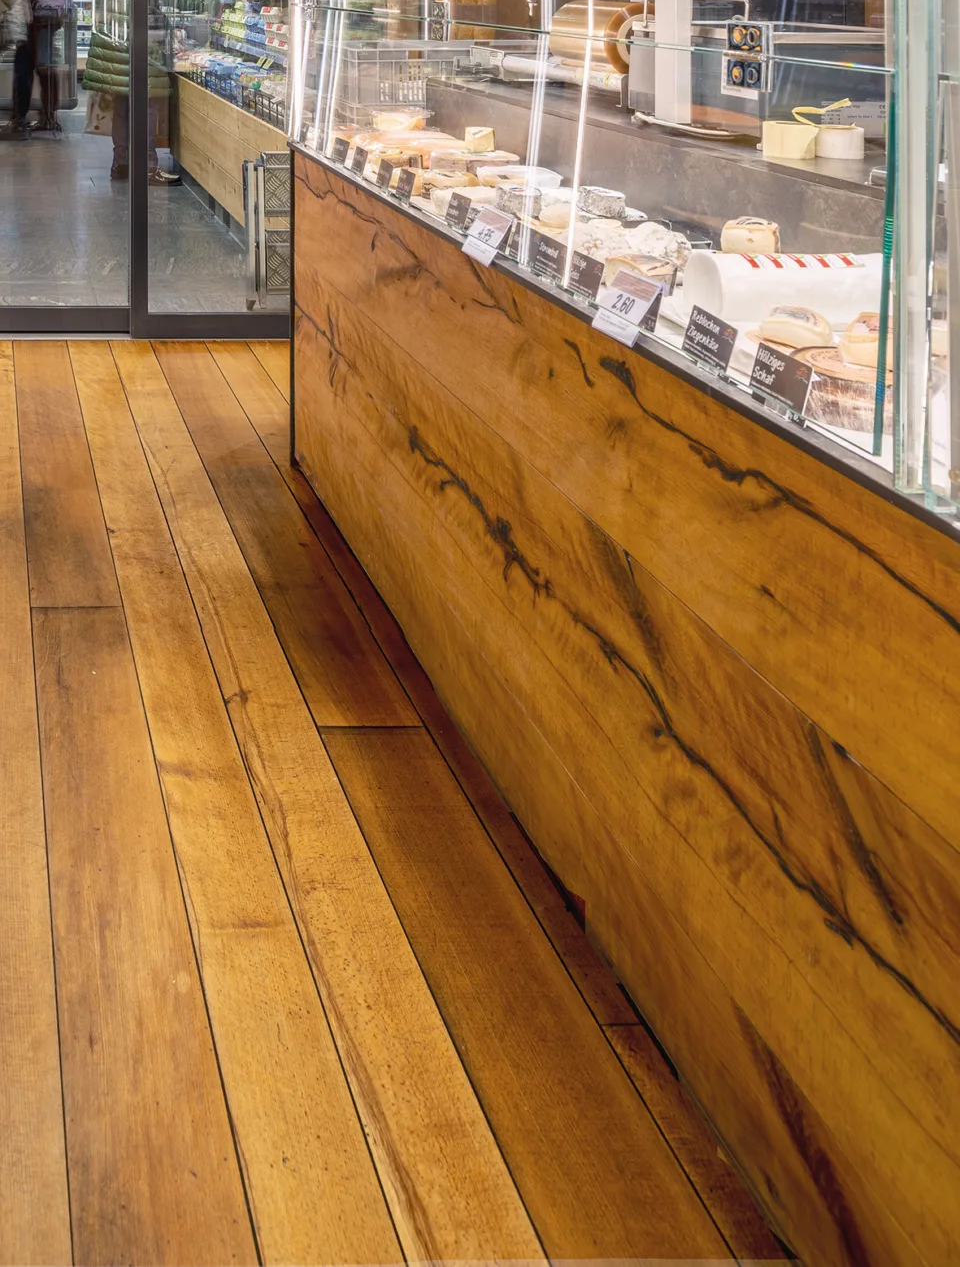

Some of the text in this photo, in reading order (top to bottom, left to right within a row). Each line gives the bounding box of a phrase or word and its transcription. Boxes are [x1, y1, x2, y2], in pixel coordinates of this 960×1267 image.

[611, 294, 635, 314] 2.60
[692, 310, 720, 334] Reblochon
[757, 348, 785, 371] Hölziges
[753, 366, 775, 385] Schaf
